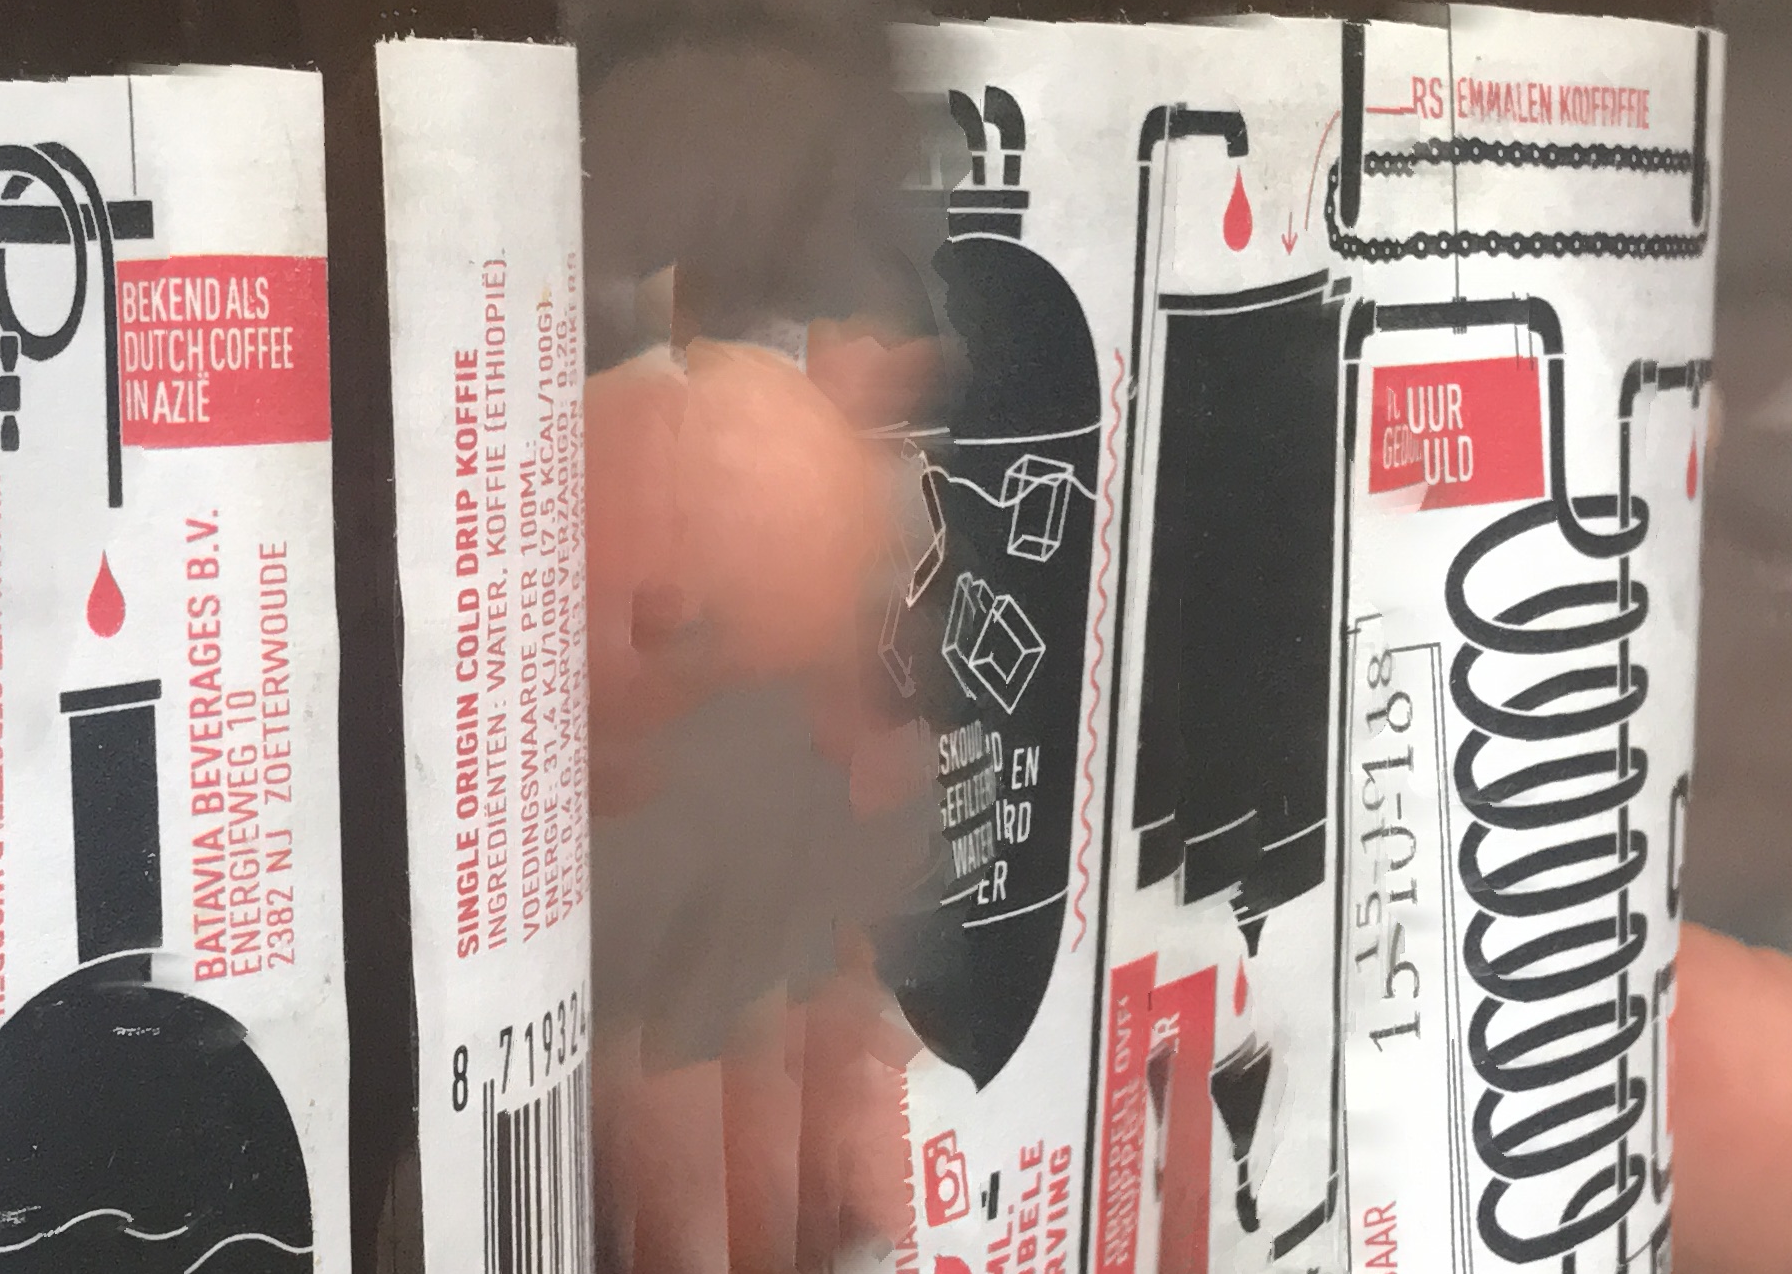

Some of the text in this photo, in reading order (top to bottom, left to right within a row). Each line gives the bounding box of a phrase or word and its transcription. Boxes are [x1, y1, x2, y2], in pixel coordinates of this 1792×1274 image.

[123, 277, 270, 323] BEKEND ALS
[124, 326, 294, 373] DUTCH COFFEE
[125, 372, 210, 424] IN AZIË
[485, 445, 507, 556] KOFFIE
[454, 348, 480, 960] SINGLE ORIGIN COLD DRIP KOFFIE
[519, 440, 541, 943] VOEDINGSWAARDE PER 100ML:
[558, 596, 572, 751] WAARVAN
[185, 509, 227, 982] BATAVIA BEVERAGES B.V.
[259, 540, 295, 968] 2382 NJ ZOETERWOUDE
[541, 706, 558, 770] 31.4
[225, 690, 262, 975] ENERGIEWEG 10
[484, 700, 508, 951] INGREDIËNTEN:
[542, 781, 559, 929] ENERGIE:
[453, 1044, 468, 1112] 8
